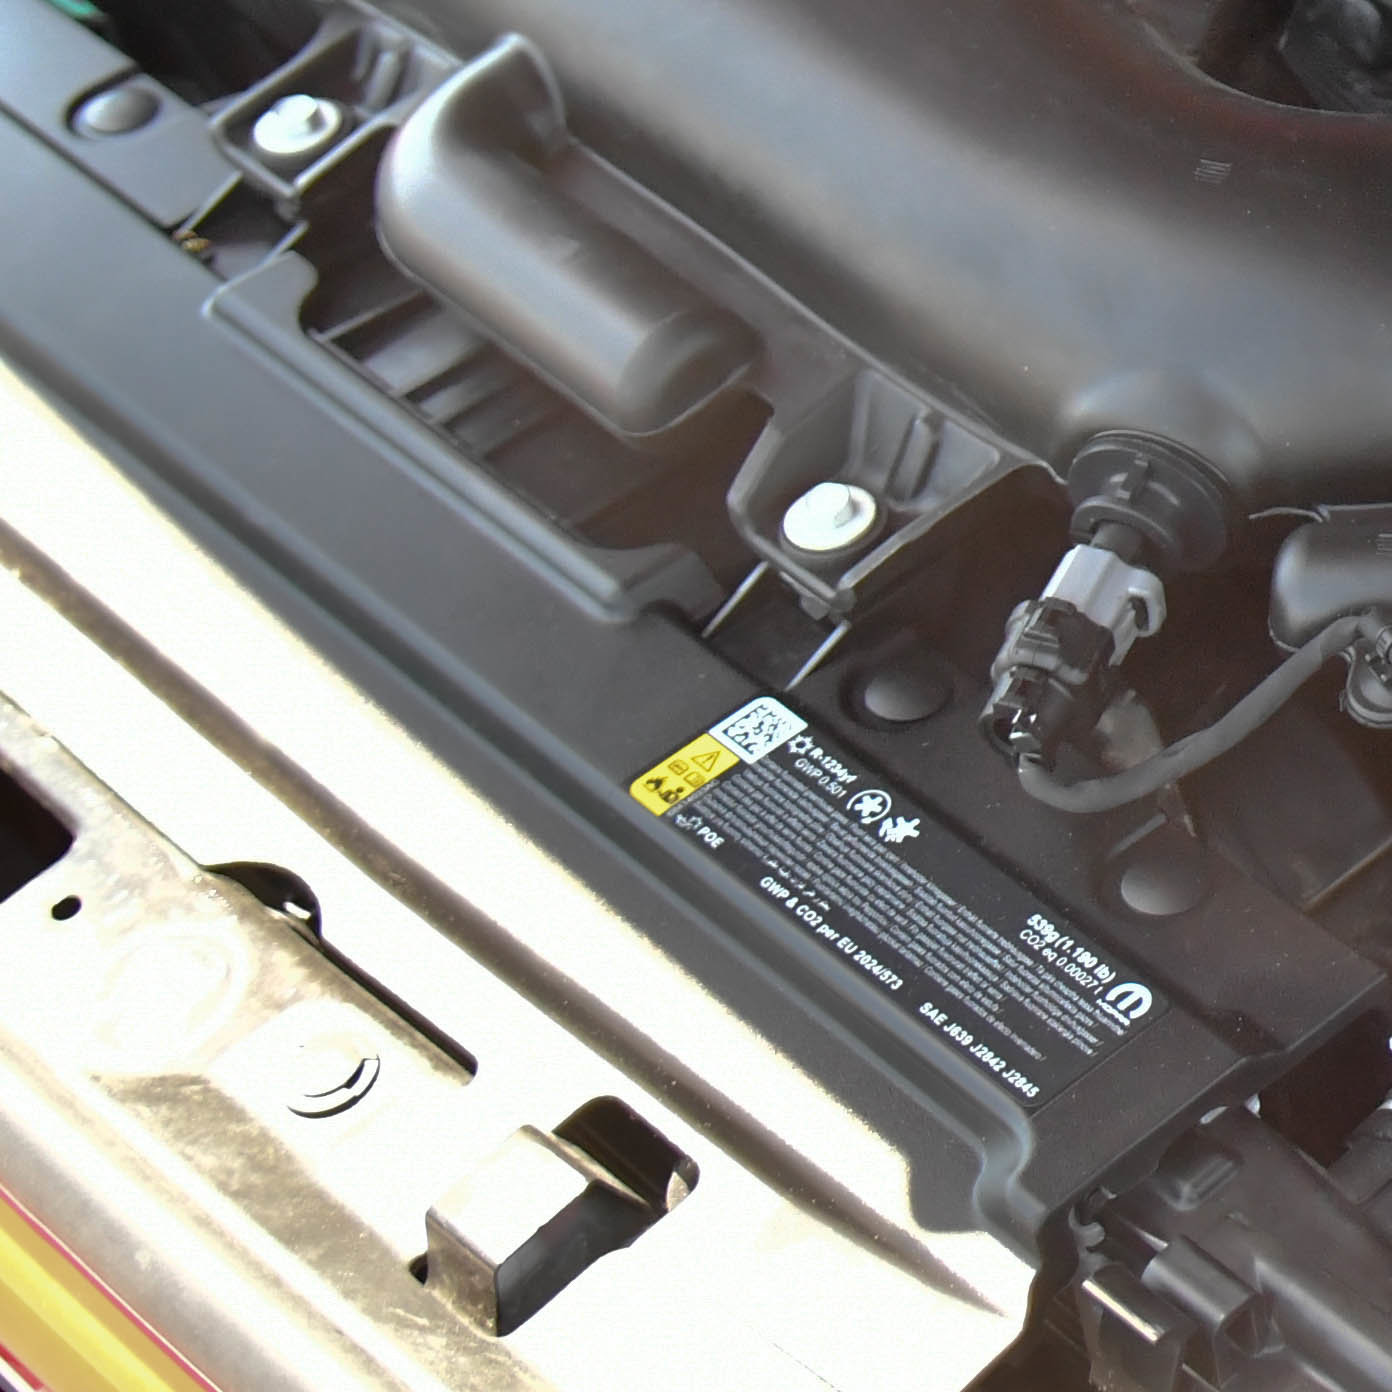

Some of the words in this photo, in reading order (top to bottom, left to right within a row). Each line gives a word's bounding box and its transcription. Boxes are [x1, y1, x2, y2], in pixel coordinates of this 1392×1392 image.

[795, 759, 822, 777] GWP
[818, 776, 847, 797] 0.501
[809, 748, 857, 783] R-1234yf
[697, 827, 724, 848] POE
[761, 877, 789, 898] GWP
[786, 897, 798, 908] &
[796, 905, 822, 926] CO2
[816, 924, 839, 940] per
[837, 937, 858, 953] EU
[853, 951, 903, 989] 2024/573
[1020, 930, 1047, 950] CO2
[1042, 948, 1057, 962] eq
[1056, 957, 1098, 988] 0.00027
[1027, 914, 1060, 943] 539g
[1094, 964, 1116, 983] lb)
[920, 1003, 948, 1025] SAE
[944, 1023, 973, 1045] J639
[970, 1044, 1006, 1071] J2842
[1002, 1070, 1039, 1097] J2845
